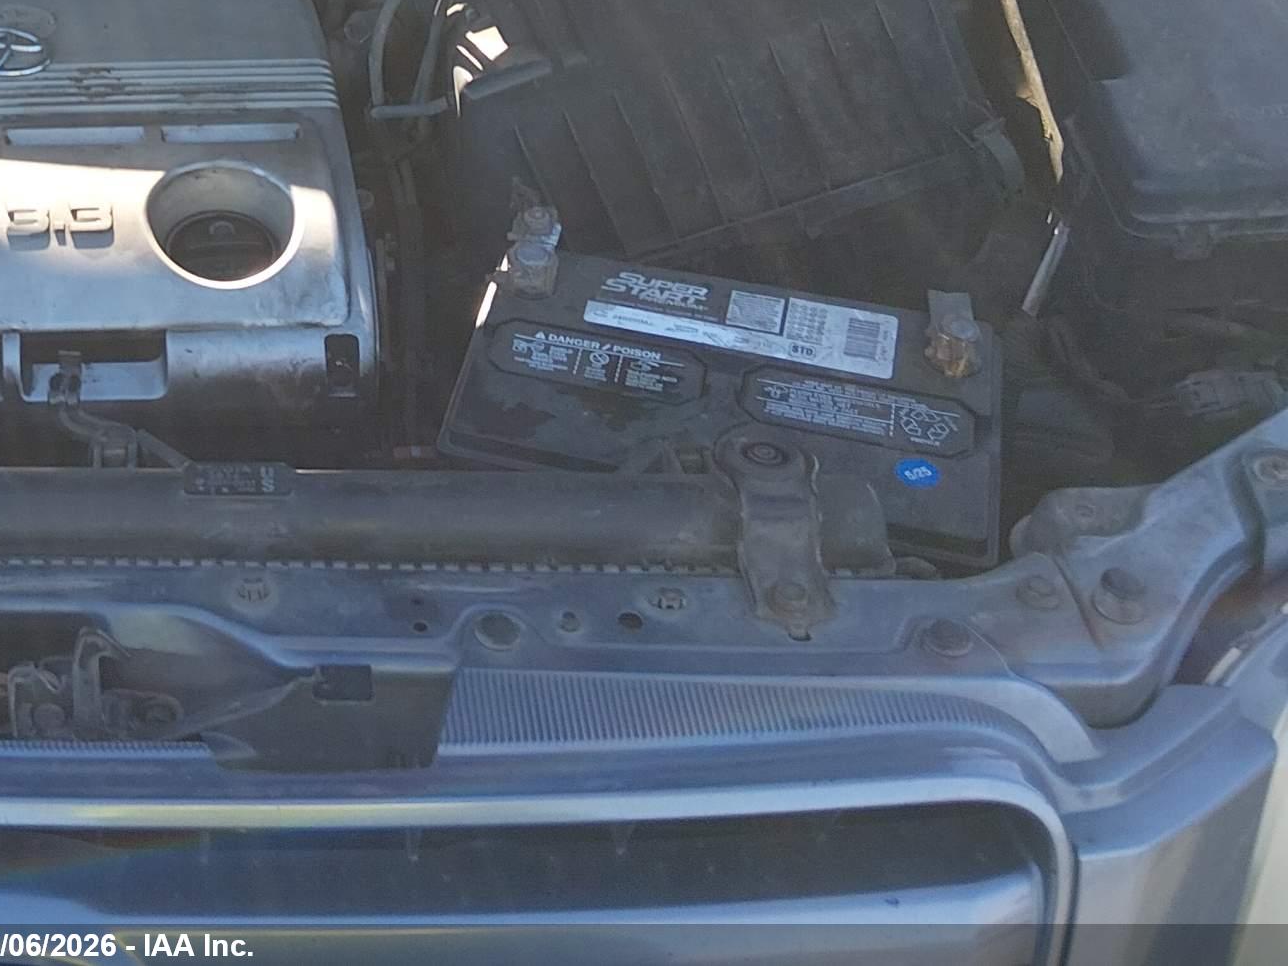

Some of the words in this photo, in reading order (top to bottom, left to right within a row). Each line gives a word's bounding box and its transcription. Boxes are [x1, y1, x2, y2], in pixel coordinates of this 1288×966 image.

[6, 205, 114, 247] 3.3
[600, 278, 708, 306] START
[618, 271, 709, 296] SUPER
[548, 333, 601, 350] DANGER
[613, 345, 662, 360] POISON
